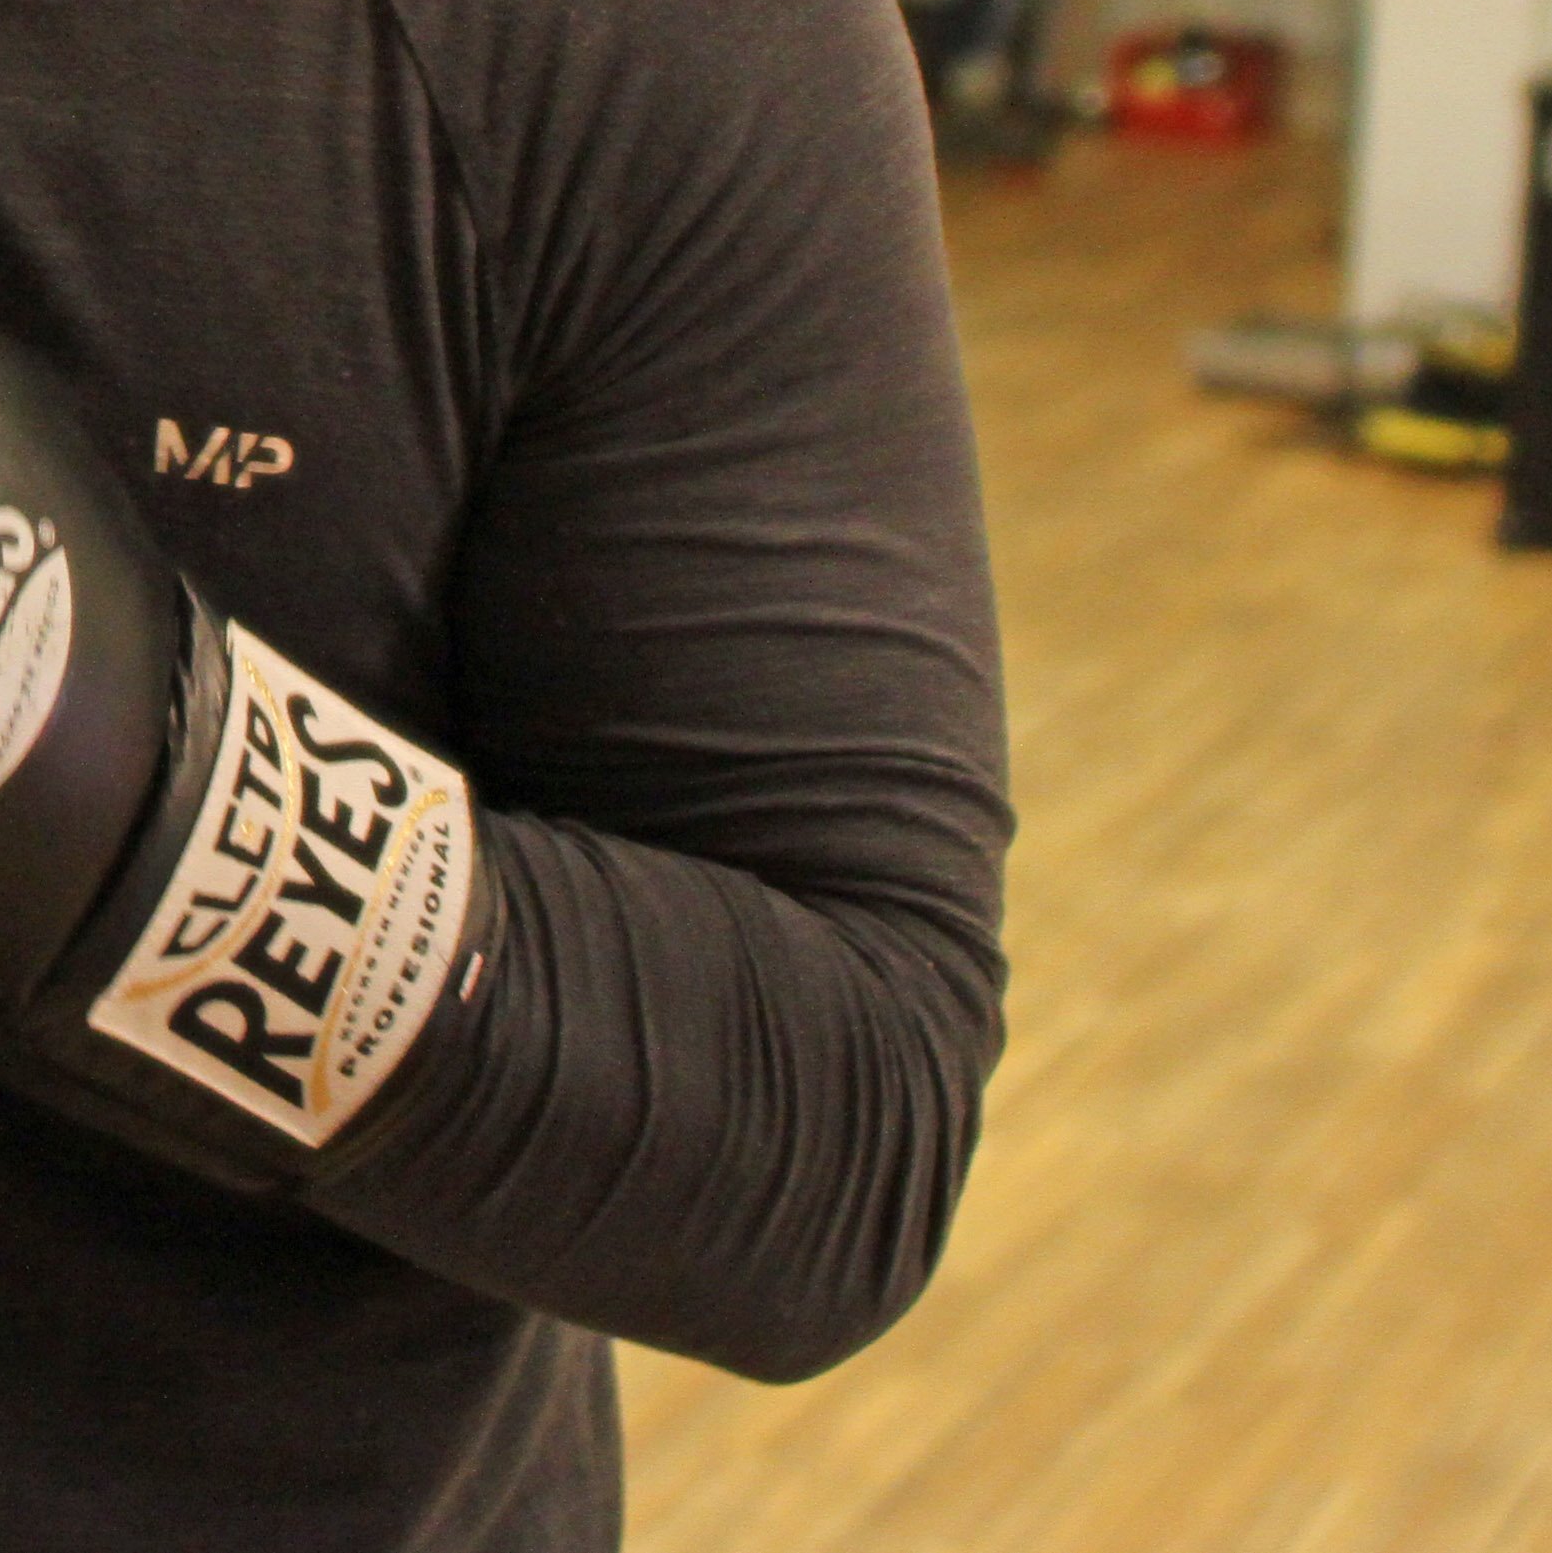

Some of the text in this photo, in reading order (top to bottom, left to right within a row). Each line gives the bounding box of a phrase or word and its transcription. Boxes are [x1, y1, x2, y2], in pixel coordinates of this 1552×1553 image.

[159, 693, 283, 957] CLETO
[167, 692, 411, 1110] REYES
[336, 822, 450, 1079] PROFESIONAL
